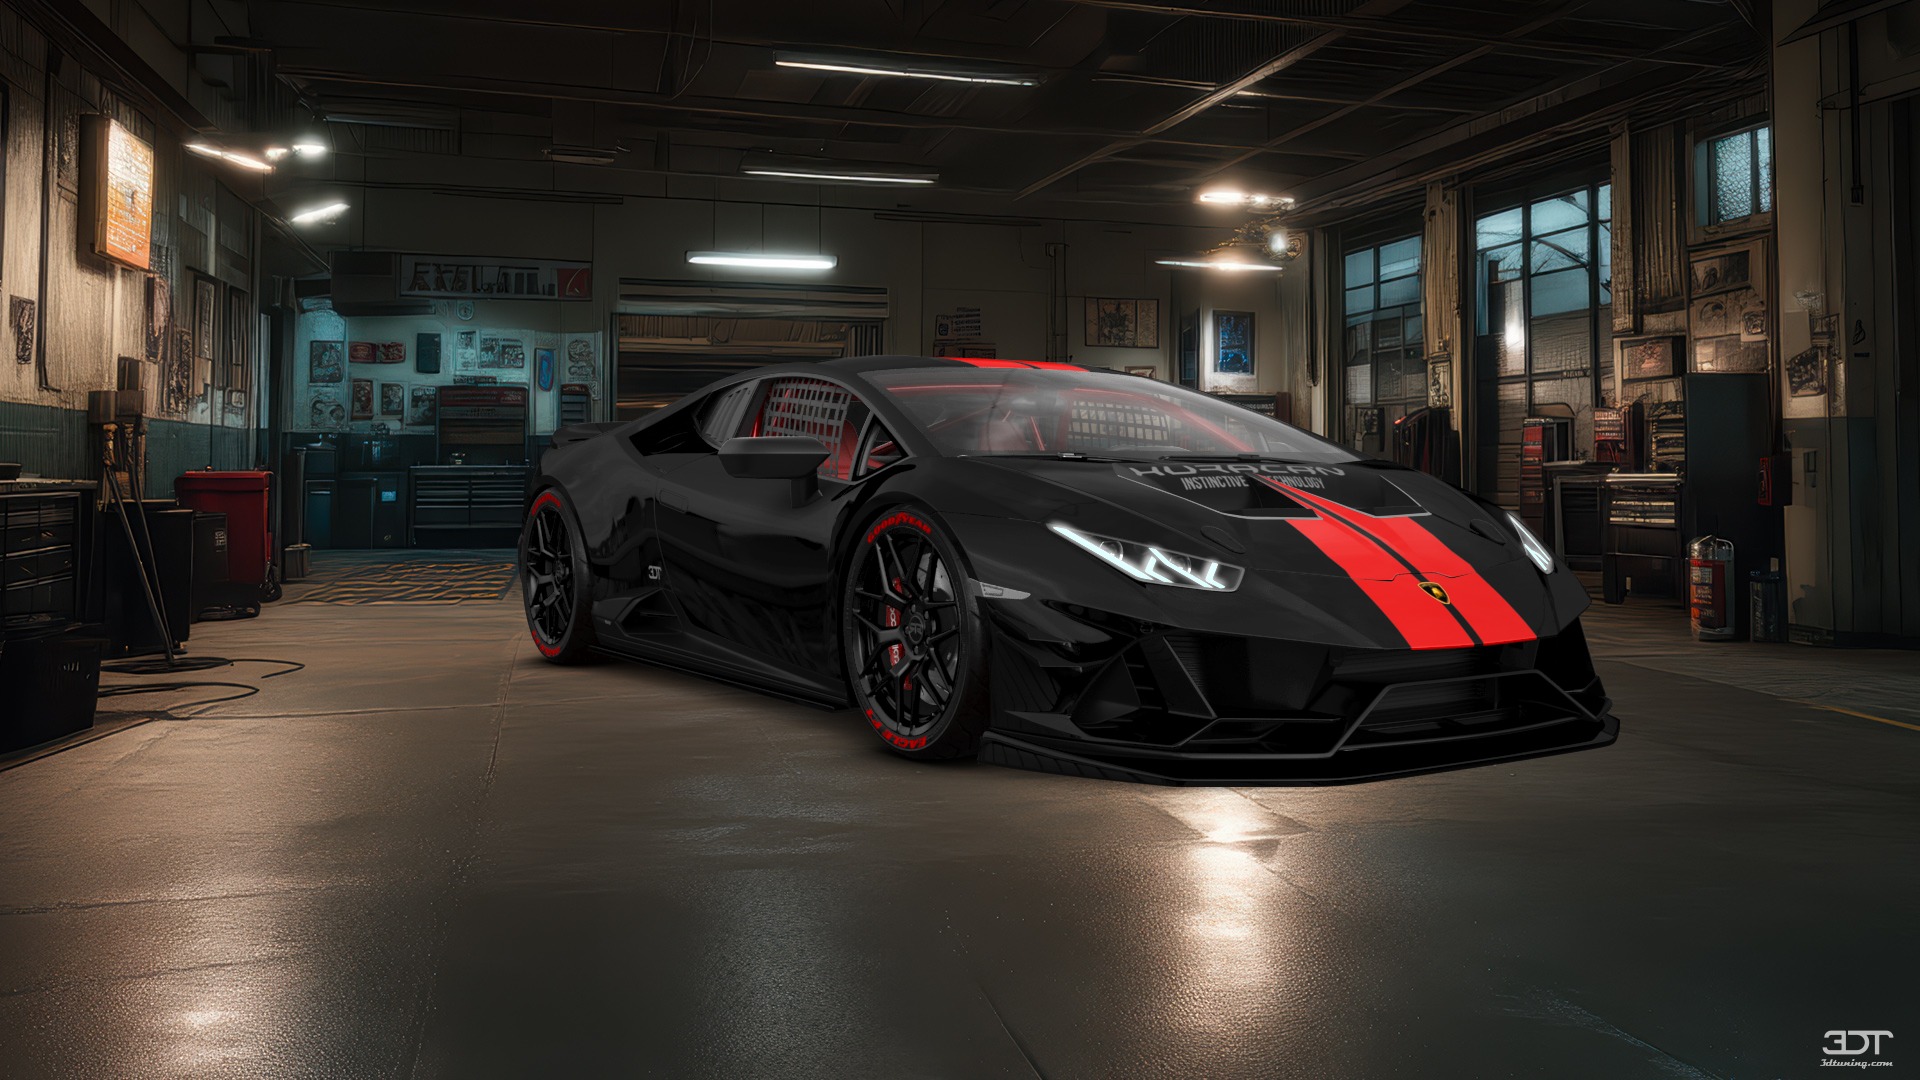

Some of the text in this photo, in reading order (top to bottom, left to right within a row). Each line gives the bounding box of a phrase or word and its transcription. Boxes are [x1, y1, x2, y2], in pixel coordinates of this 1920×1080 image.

[1180, 475, 1326, 491] INSTINCTIVE CHNOLOGY
[866, 511, 932, 544] GOODYEAR
